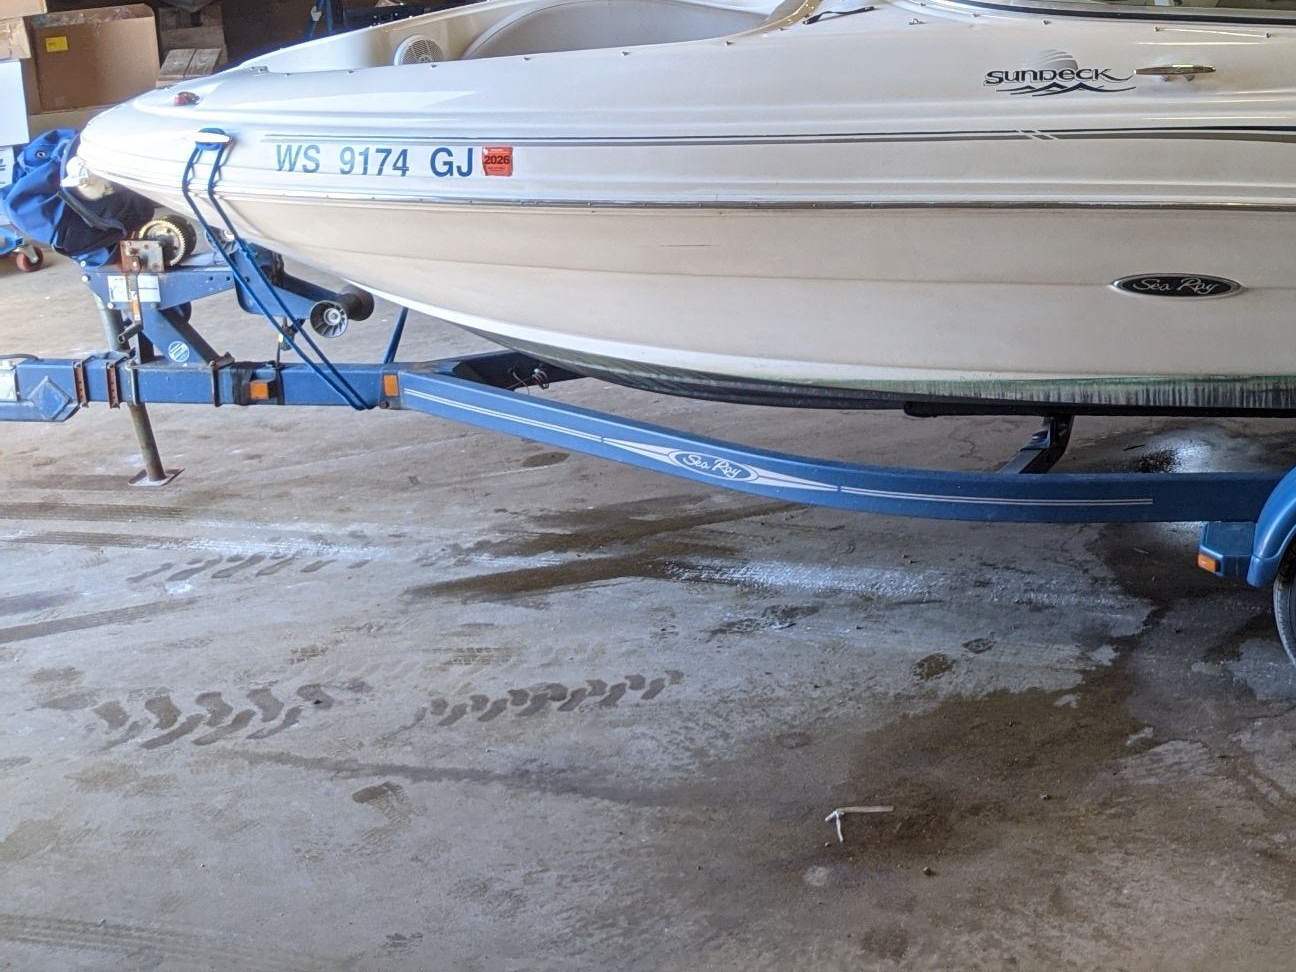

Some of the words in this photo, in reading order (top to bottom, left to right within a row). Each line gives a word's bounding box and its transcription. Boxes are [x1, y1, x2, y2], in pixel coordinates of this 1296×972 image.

[275, 144, 321, 174] WS
[339, 146, 410, 177] 9174
[430, 147, 474, 177] GJ
[484, 155, 511, 165] 2026
[1133, 278, 1172, 291] Sea
[1176, 277, 1220, 295] Ray
[683, 454, 712, 470] Sea
[712, 459, 742, 479] Ray
